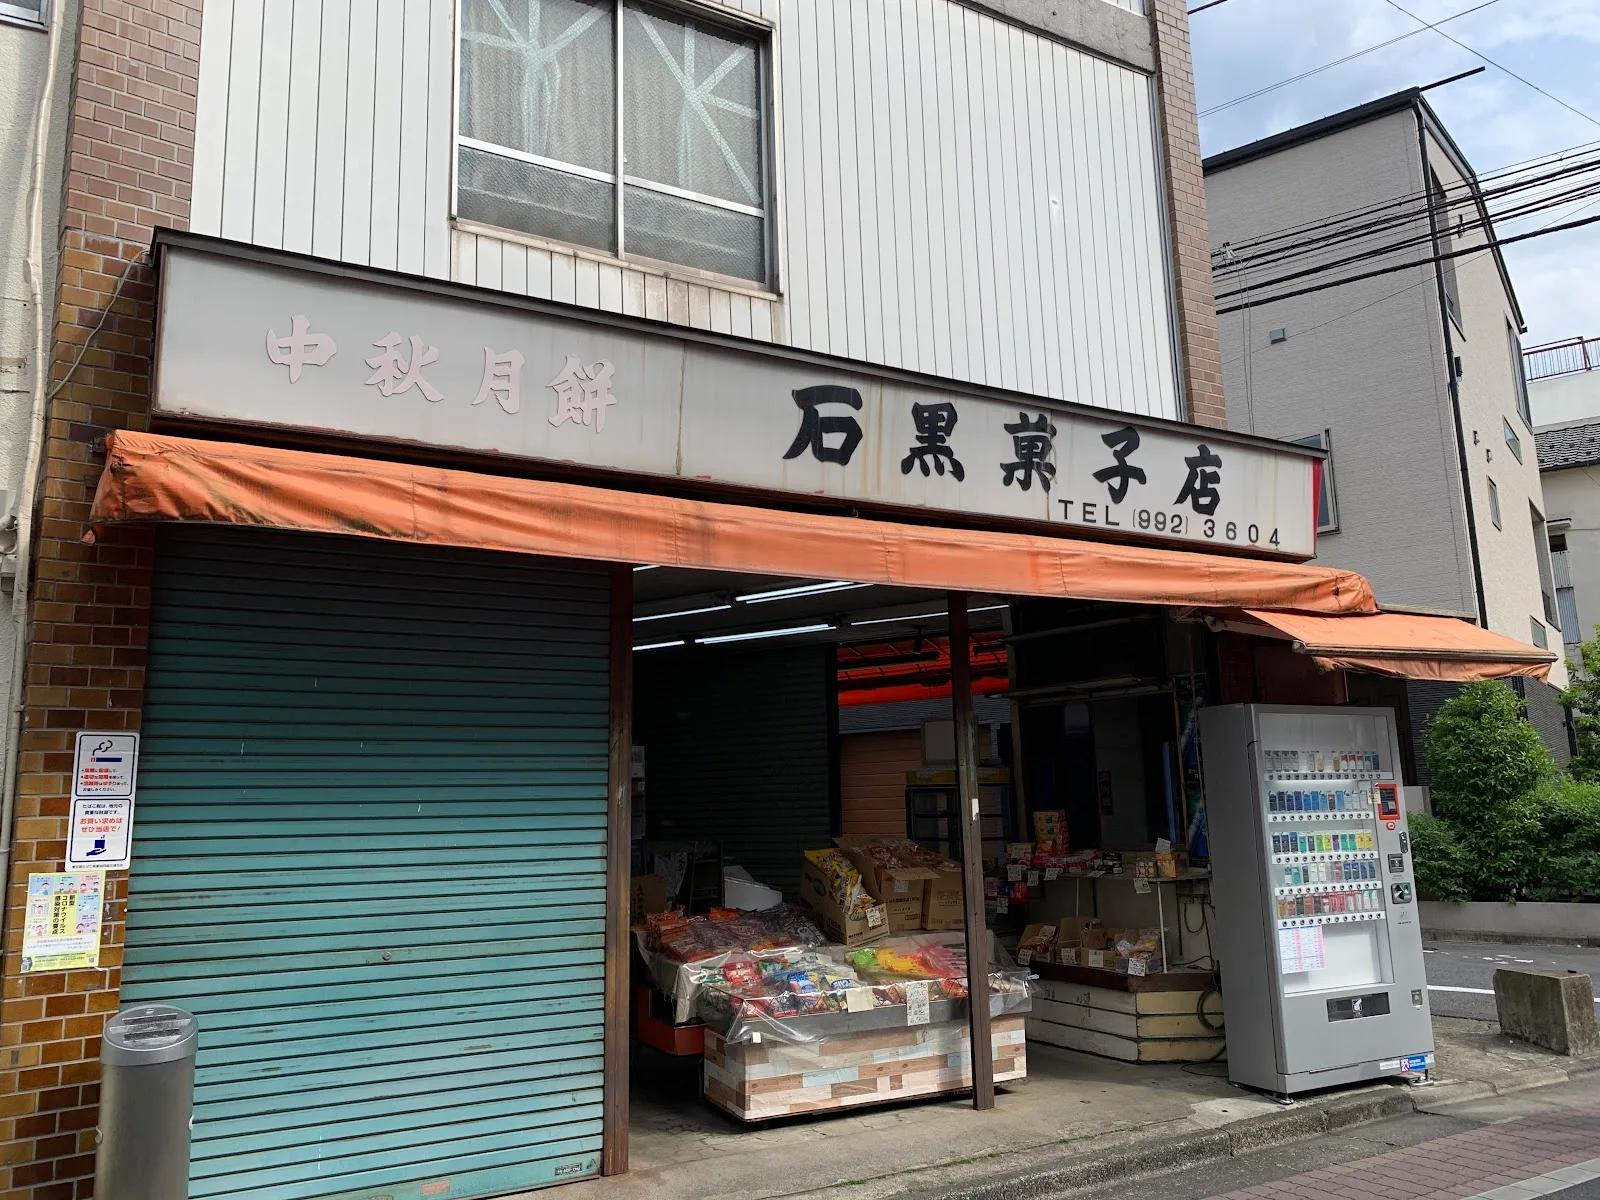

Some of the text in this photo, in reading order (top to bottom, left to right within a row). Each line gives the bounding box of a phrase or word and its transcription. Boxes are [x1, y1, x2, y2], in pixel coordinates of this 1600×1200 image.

[266, 315, 617, 434] 中秋月餅
[783, 385, 1223, 516] 石黒菓子店
[1058, 499, 1281, 548] TEL (992) 3604
[79, 817, 123, 825] お買い求めは
[59, 895, 68, 934] コロナウイルス
